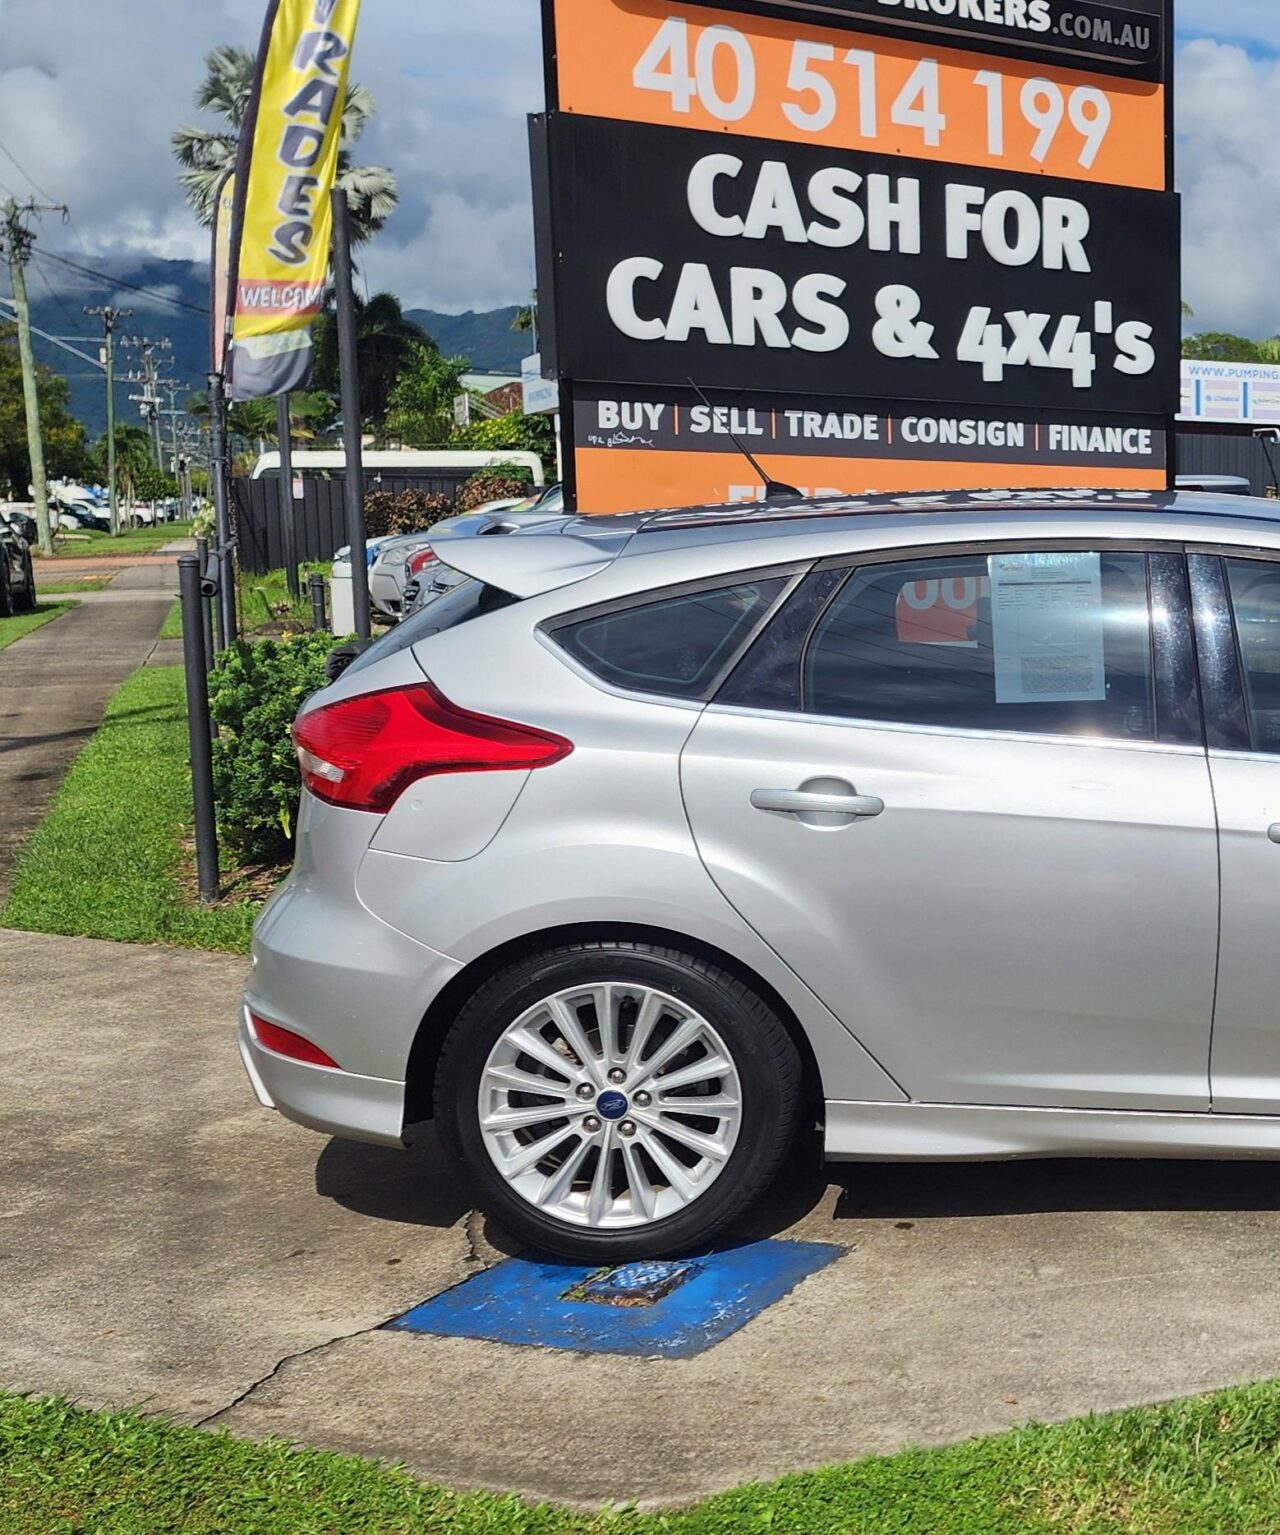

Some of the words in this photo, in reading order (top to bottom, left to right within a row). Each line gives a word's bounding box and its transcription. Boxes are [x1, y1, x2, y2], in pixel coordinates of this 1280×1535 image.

[632, 16, 757, 121] 40
[780, 39, 946, 148] 514
[972, 70, 1112, 170] 199
[687, 152, 921, 255] CASH
[945, 182, 1092, 273] FOR
[606, 256, 850, 354] CARS
[872, 284, 939, 360] &
[597, 400, 665, 431] BUY
[690, 405, 764, 437] SELL
[784, 410, 880, 442] TRADE
[901, 416, 1025, 449] CONSIGN
[1049, 424, 1153, 456] FINANCE
